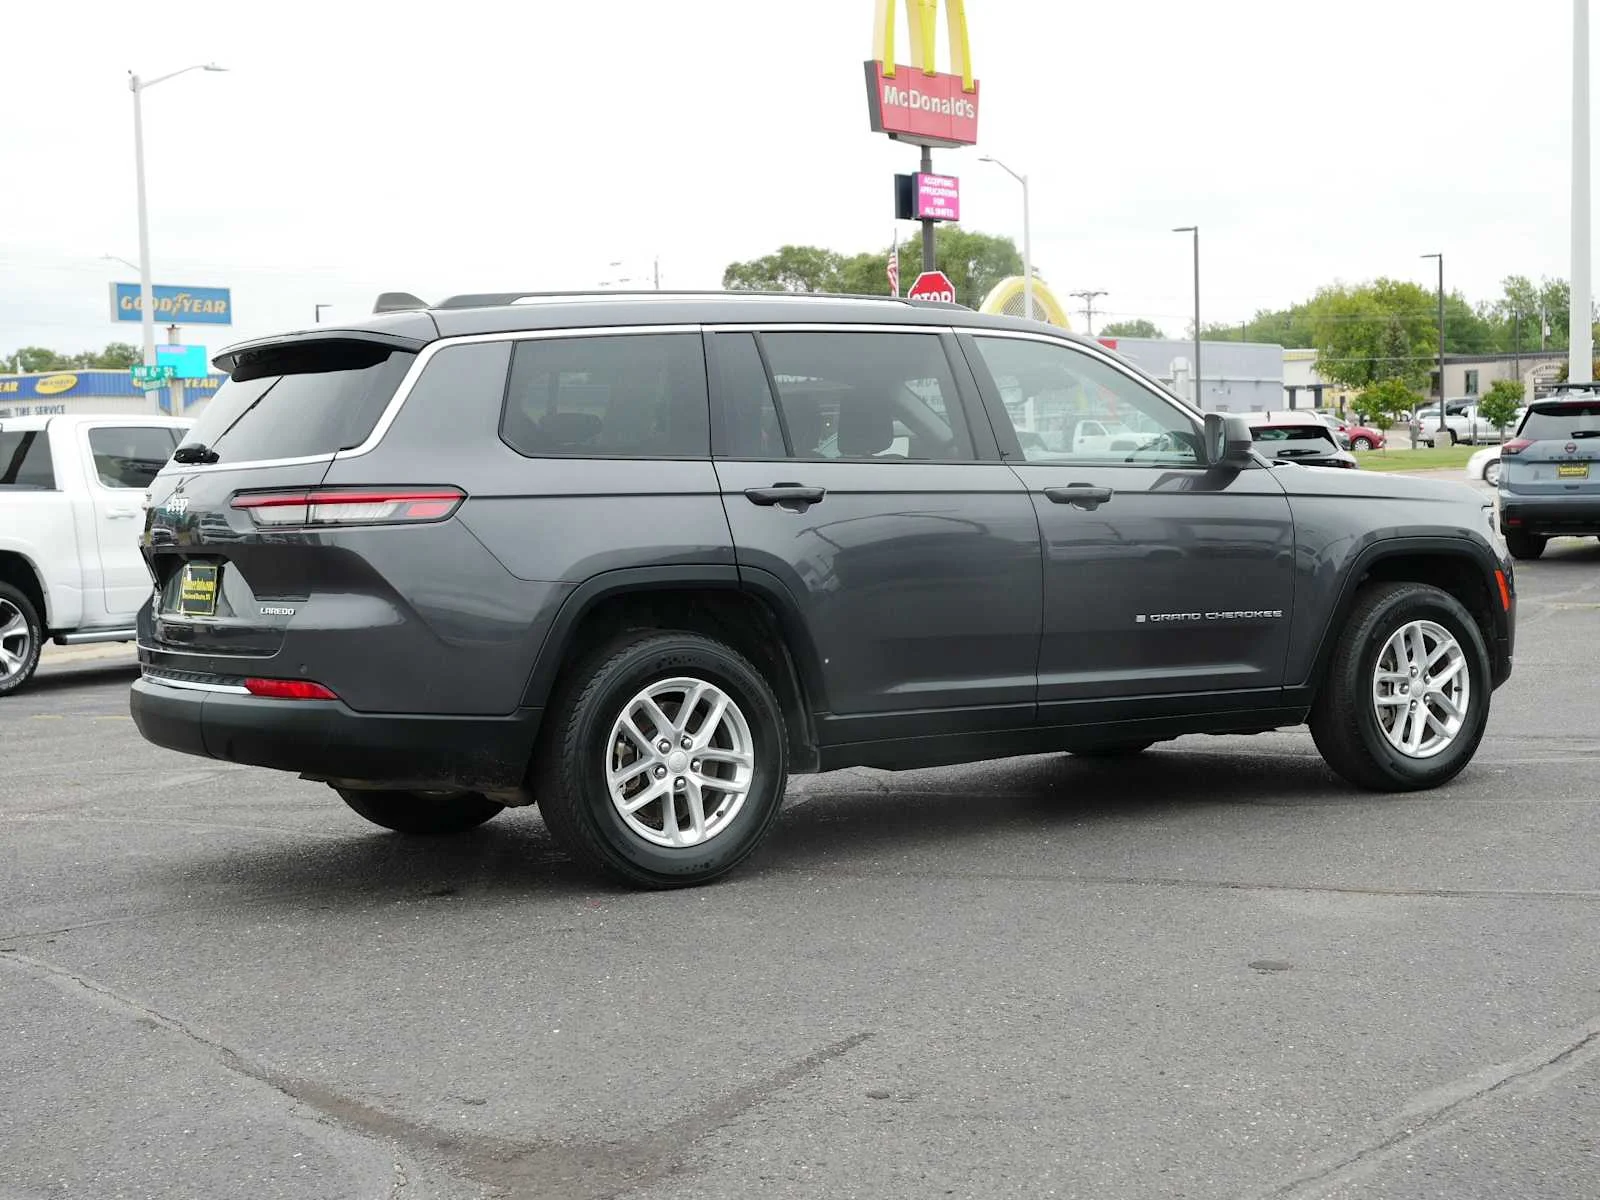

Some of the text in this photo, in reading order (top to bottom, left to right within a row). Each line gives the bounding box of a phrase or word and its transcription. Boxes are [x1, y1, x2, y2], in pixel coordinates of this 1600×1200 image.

[883, 84, 975, 119] McDonald's
[35, 404, 65, 416] SERVICE
[260, 607, 295, 616] LAREDO
[1150, 610, 1283, 622] GRAND CHEROKEE
